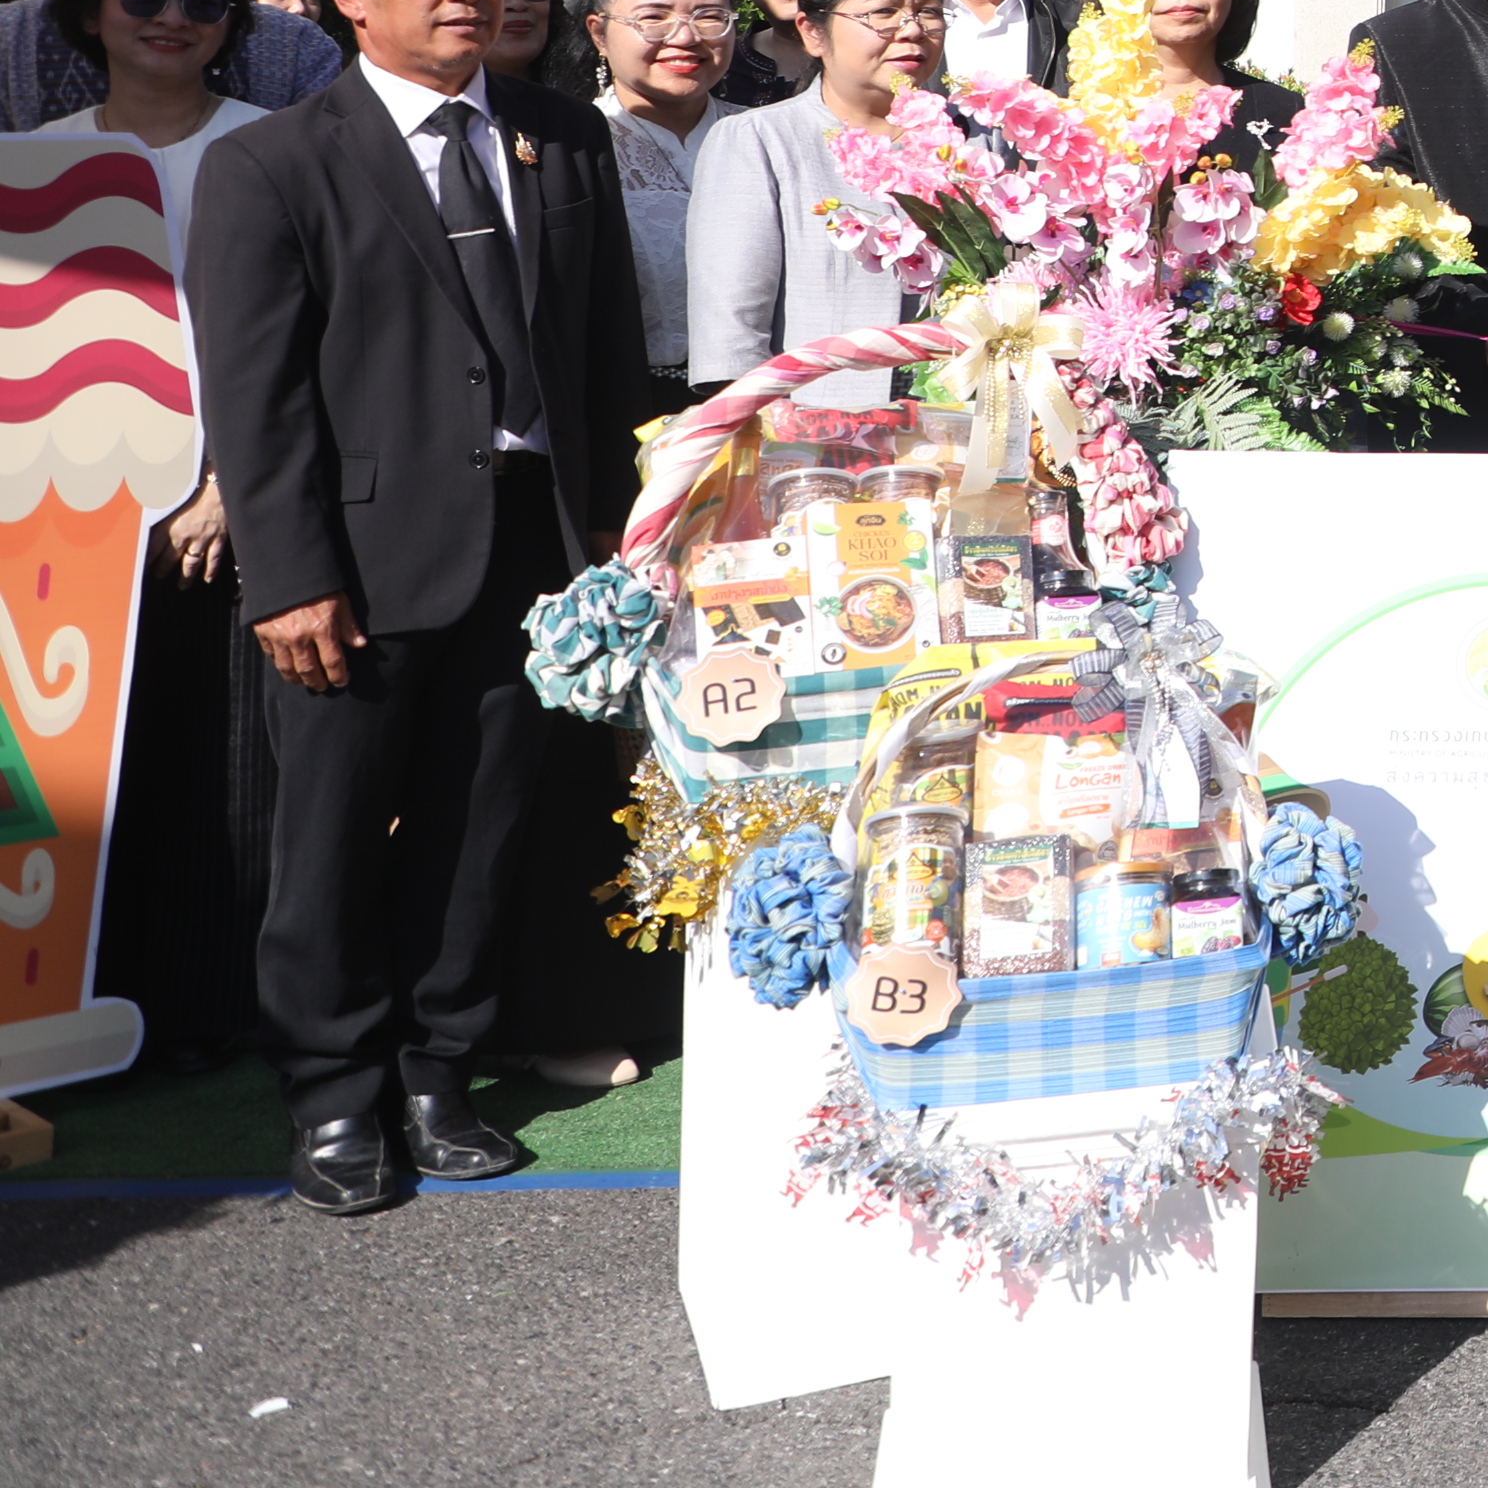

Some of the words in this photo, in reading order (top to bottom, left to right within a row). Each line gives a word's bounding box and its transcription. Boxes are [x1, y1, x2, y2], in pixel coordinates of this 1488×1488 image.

[848, 537, 897, 550] KHAO
[858, 549, 888, 561] SOI
[1047, 613, 1080, 623] Mulberry
[701, 678, 758, 718] A2
[1178, 920, 1217, 931] Mulberry
[1220, 918, 1237, 927] Jam
[871, 976, 928, 1014] B3
